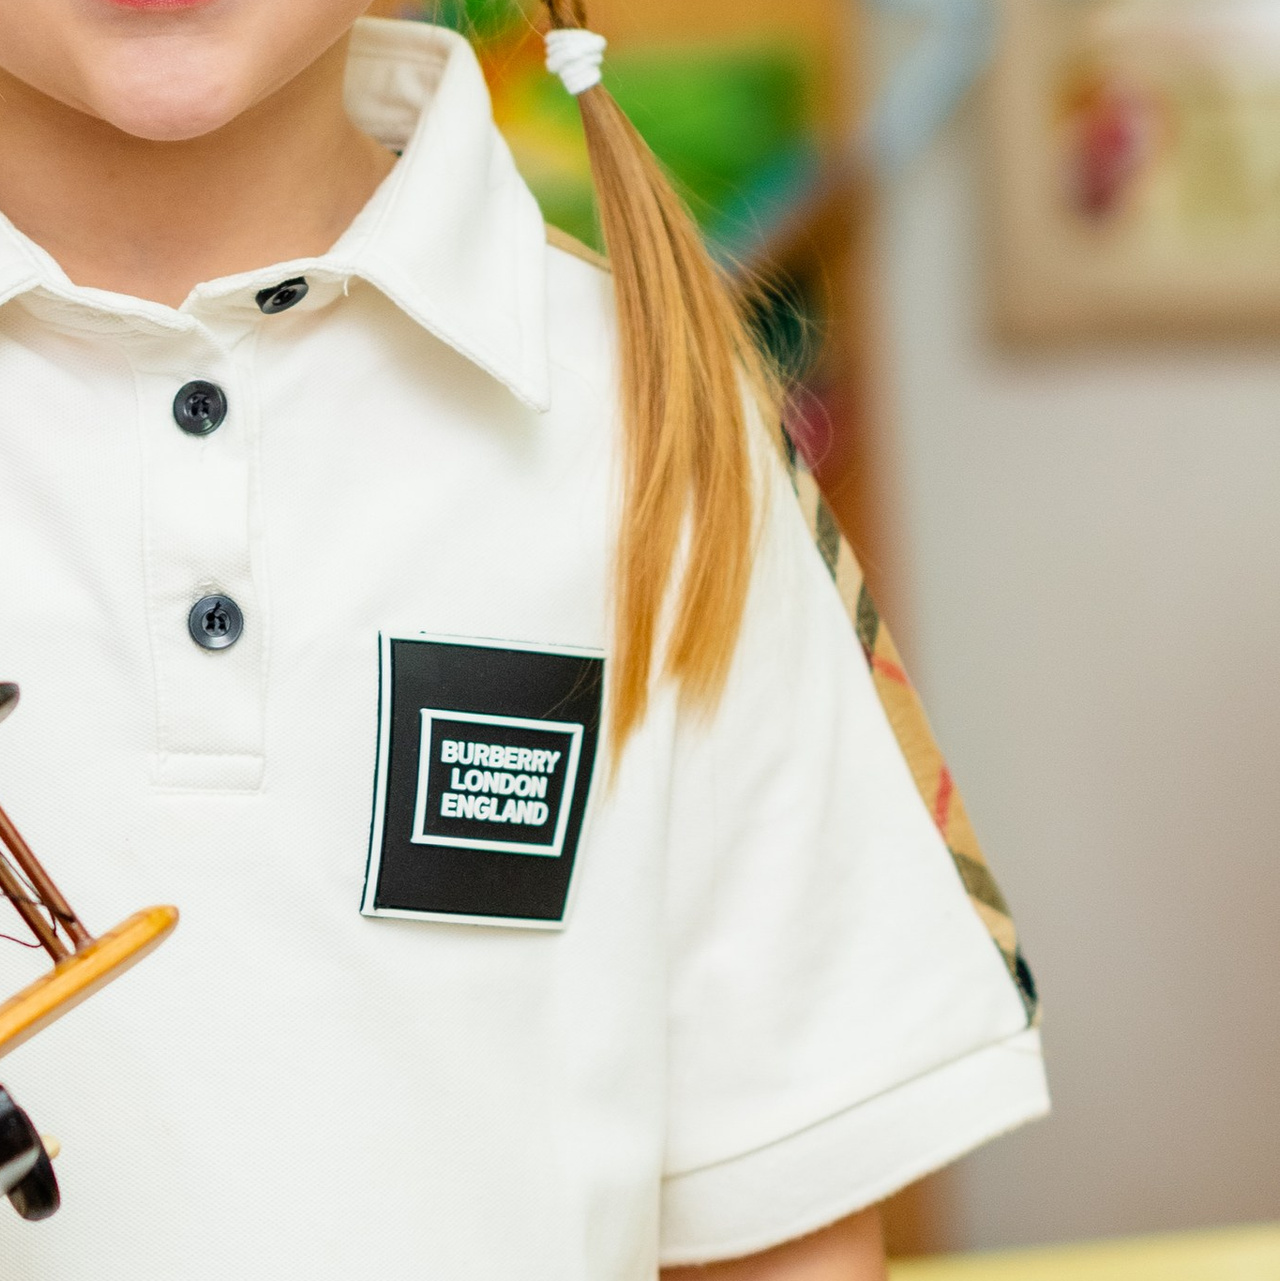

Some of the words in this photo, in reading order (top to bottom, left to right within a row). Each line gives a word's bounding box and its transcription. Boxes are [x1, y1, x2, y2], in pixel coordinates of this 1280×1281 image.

[441, 740, 561, 773] BURBERRY
[450, 768, 548, 798] LONDON
[440, 793, 549, 825] ENGLAND
